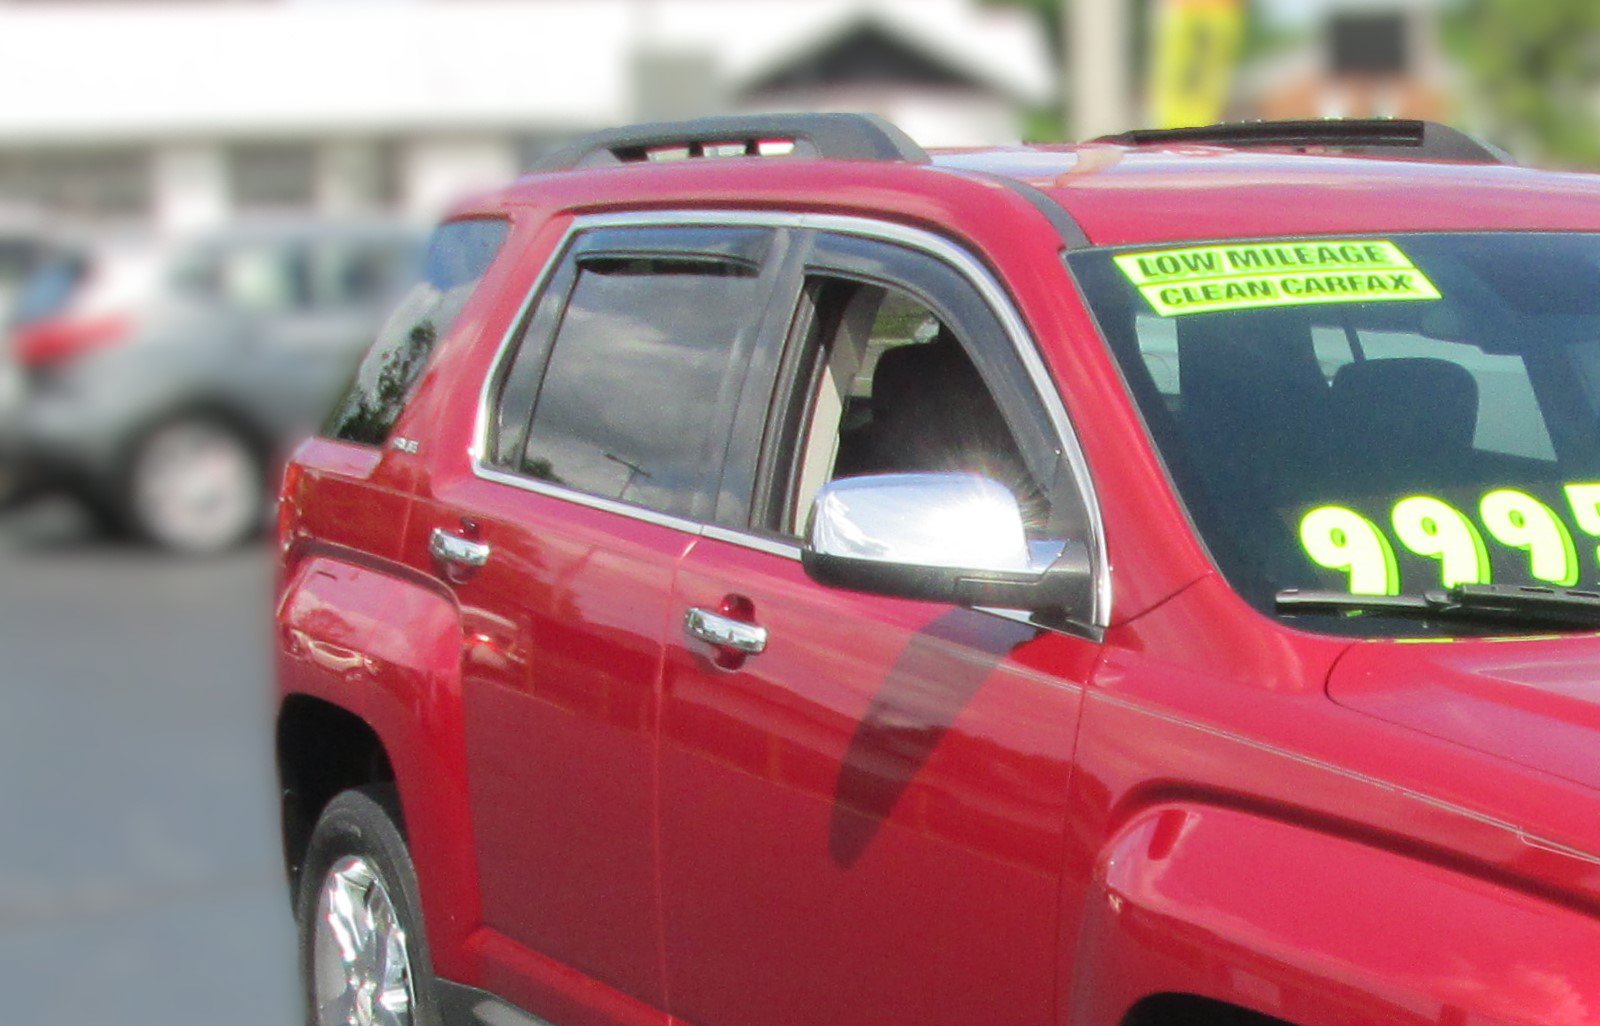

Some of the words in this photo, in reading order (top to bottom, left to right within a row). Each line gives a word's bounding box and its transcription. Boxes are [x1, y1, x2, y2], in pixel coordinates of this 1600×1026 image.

[1137, 252, 1214, 277] LOW
[1229, 245, 1382, 268] MILEAGE
[1160, 279, 1271, 305] CLEAN
[1280, 274, 1411, 294] CARFAX
